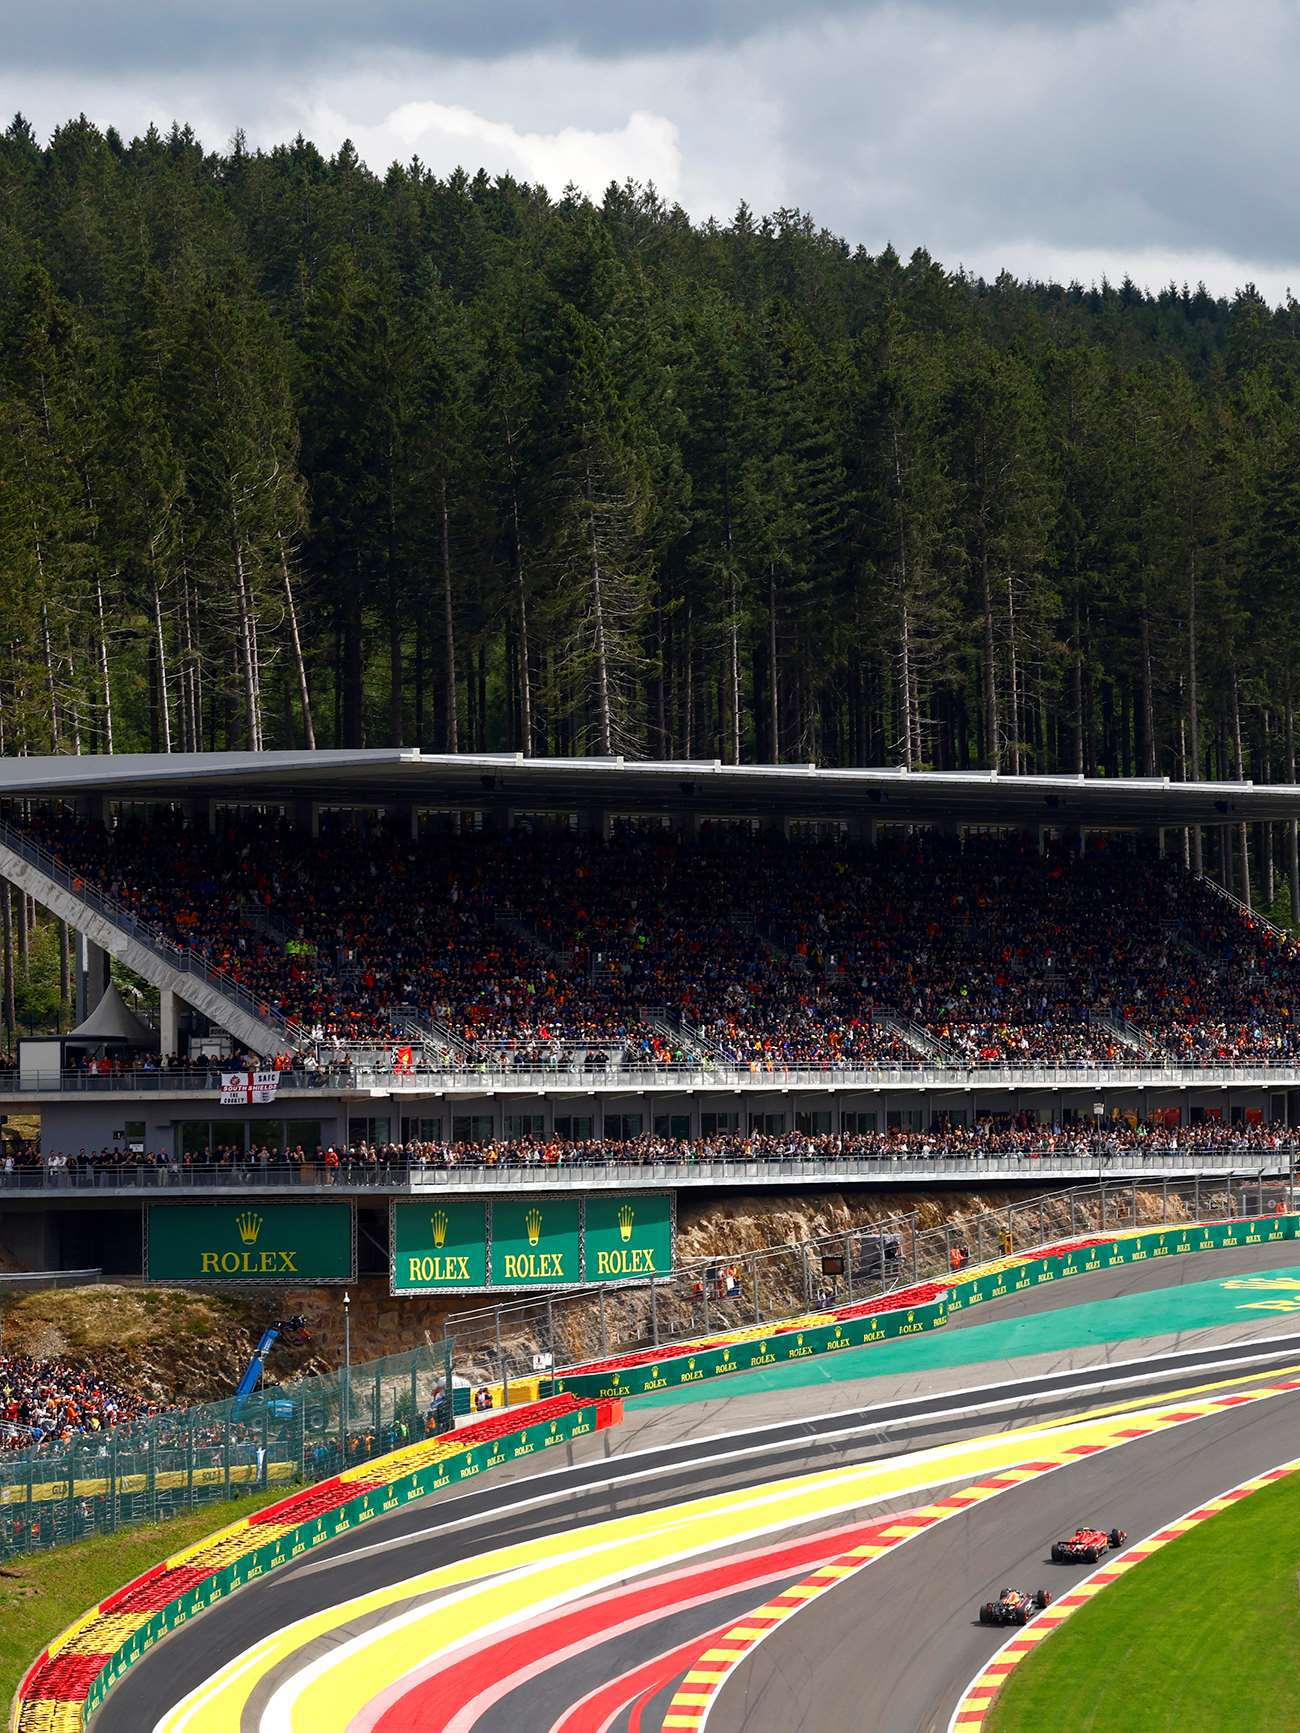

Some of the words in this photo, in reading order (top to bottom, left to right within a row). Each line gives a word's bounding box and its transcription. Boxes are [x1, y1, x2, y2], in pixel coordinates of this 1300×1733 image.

[258, 1074, 276, 1082] SAFC
[200, 1252, 298, 1273] ROLEX
[504, 1253, 564, 1277] ROLEX
[597, 1249, 656, 1274] ROLEX
[409, 1256, 470, 1280] ROLEX
[863, 1330, 885, 1342] ROLEX
[827, 1338, 849, 1350] ROLEX
[789, 1346, 812, 1358] ROLEX
[751, 1354, 775, 1366] ROLEX
[716, 1361, 737, 1373] ROLEX
[681, 1370, 703, 1382] ROLEX
[645, 1378, 667, 1390] ROLEX
[600, 1386, 630, 1397] ROLEX
[572, 1424, 589, 1436] ROLEX
[545, 1434, 563, 1446] ROLEX
[514, 1443, 534, 1456] ROLEX
[487, 1454, 505, 1467] ROLEX
[460, 1466, 479, 1478] ROLEX
[434, 1476, 449, 1488] ROLEX
